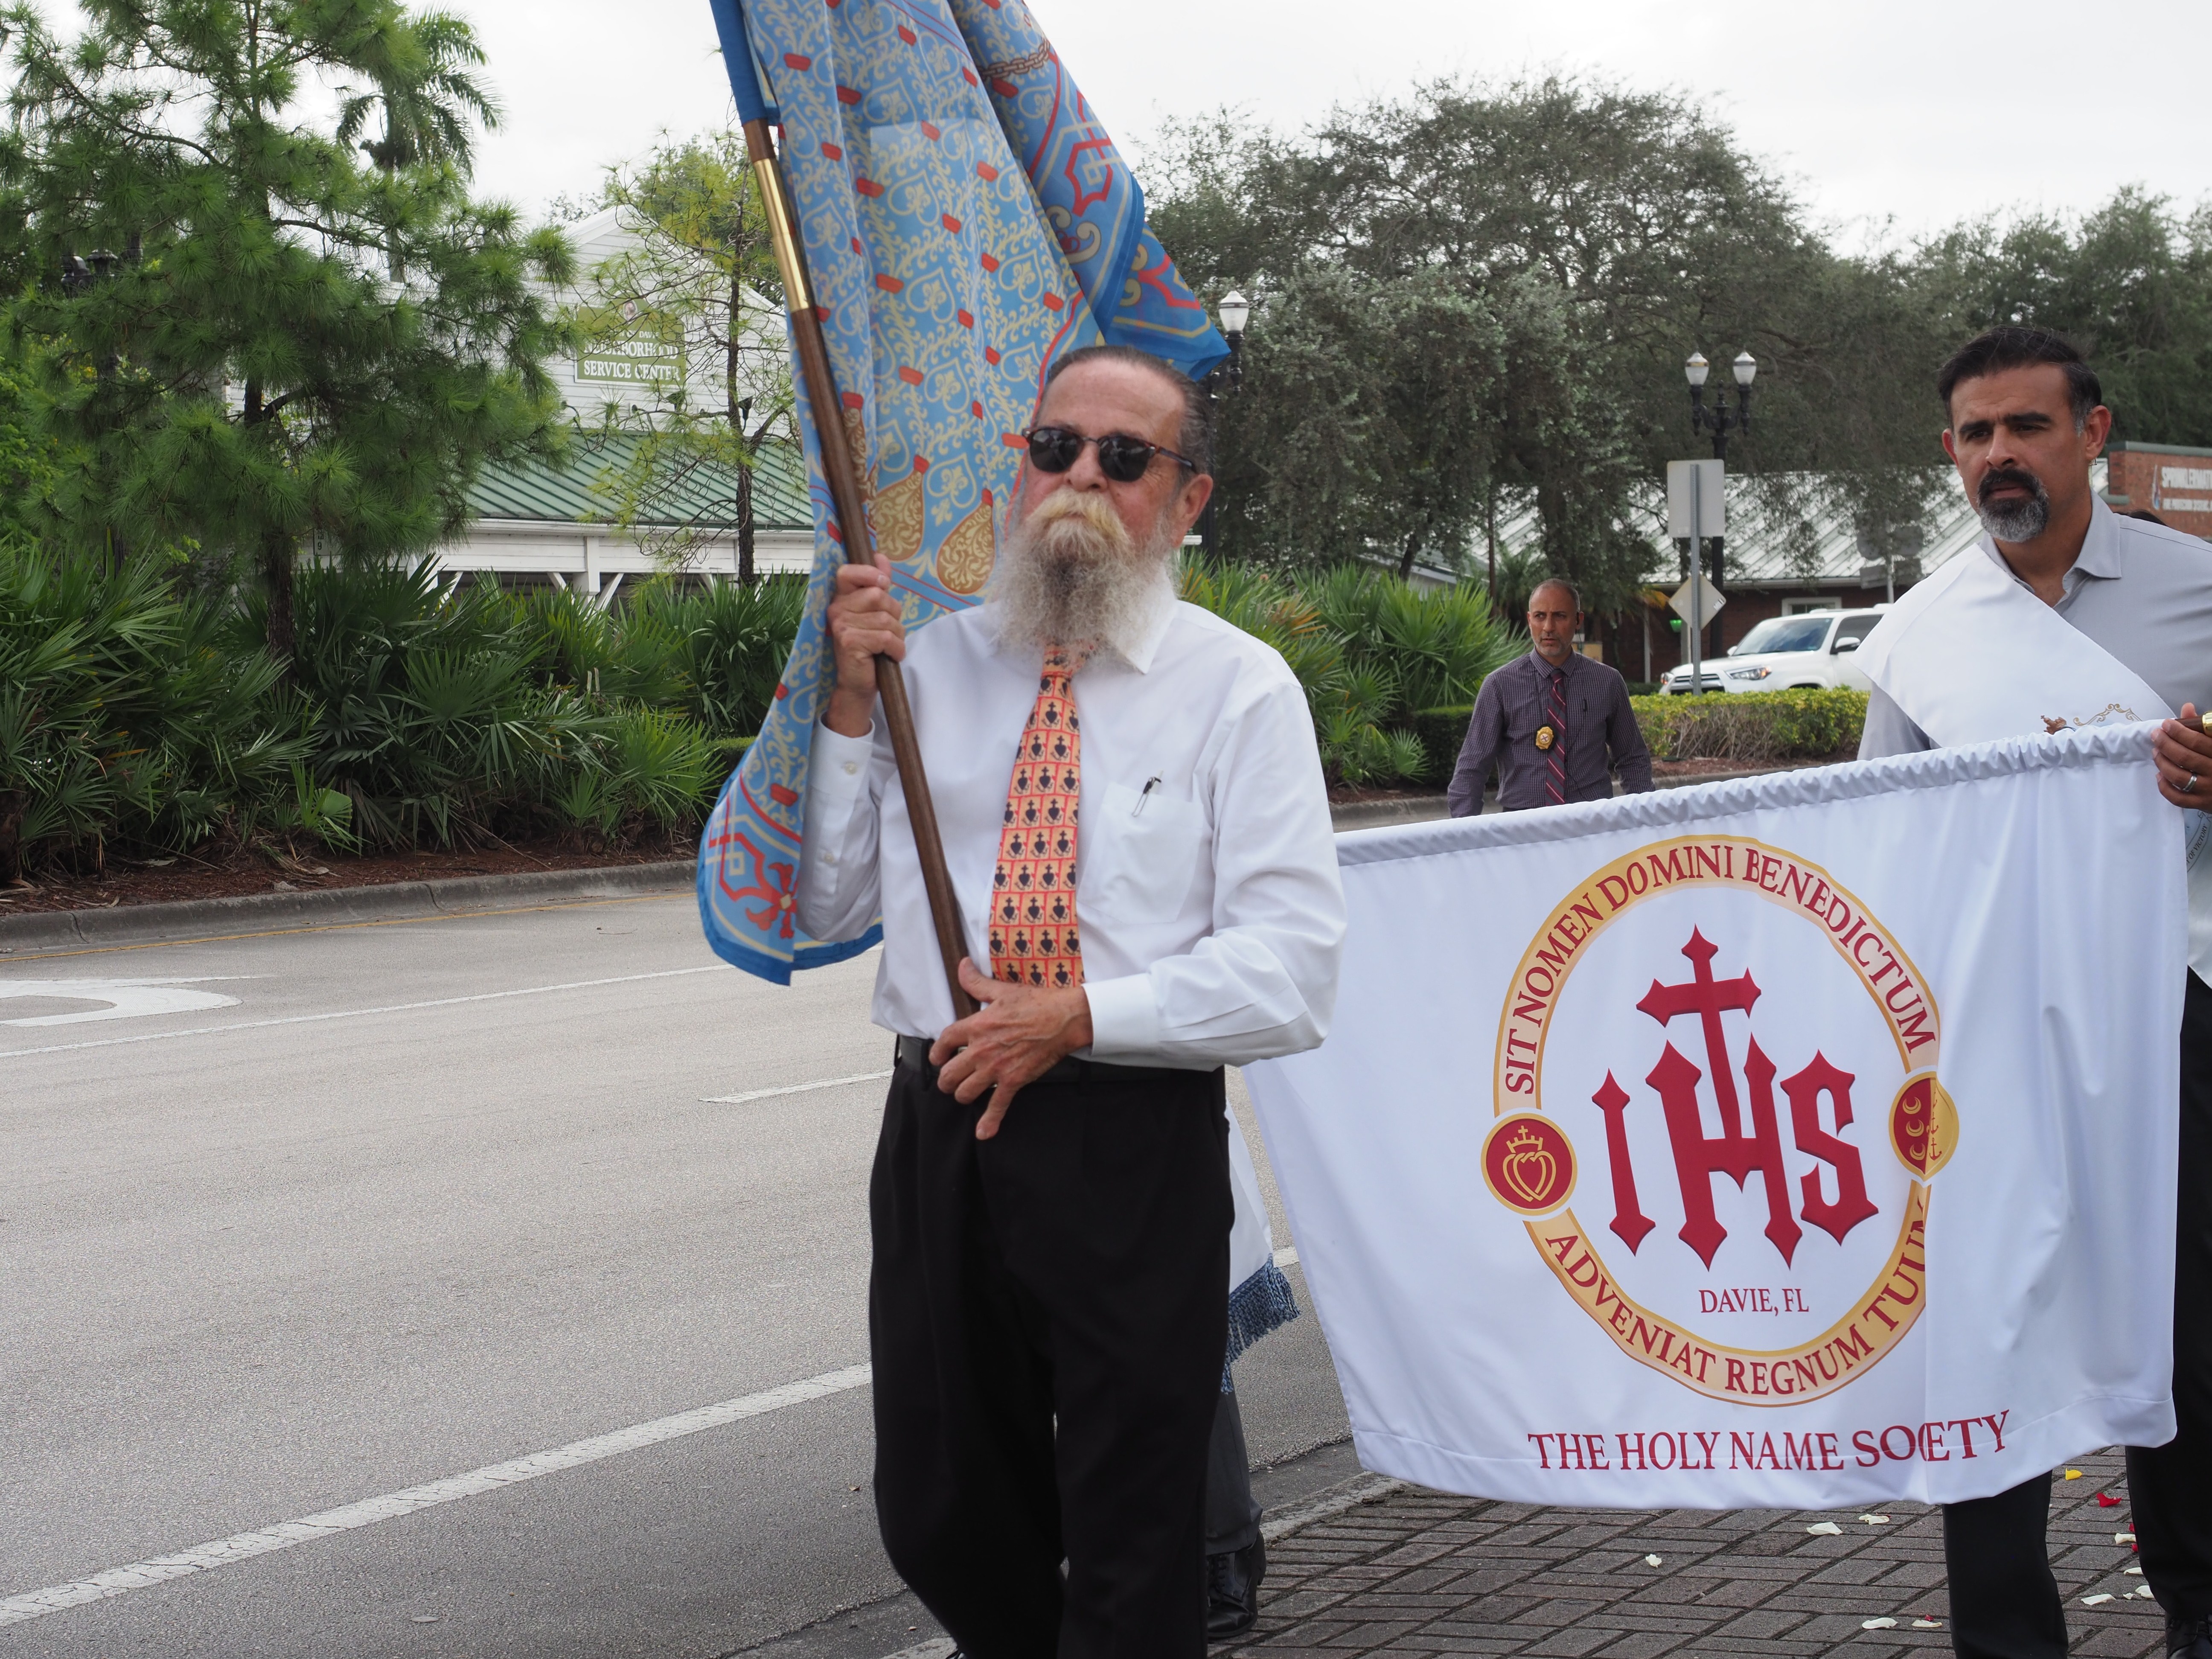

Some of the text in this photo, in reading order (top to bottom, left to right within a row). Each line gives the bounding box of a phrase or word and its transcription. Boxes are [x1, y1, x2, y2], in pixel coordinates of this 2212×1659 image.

[584, 360, 681, 381] SERVICE CENTER
[2189, 824, 2207, 860] OF VICTORY
[1505, 844, 1936, 1095] SIT NOMEN DOMINI BENEDICTUM
[1544, 1234, 1717, 1383] ADVENIAT
[1724, 1324, 1875, 1396] REGNUM
[1699, 1287, 1809, 1317] DAVIE, FL
[1527, 1432, 1610, 1470] THE
[1615, 1431, 1720, 1471] HOLY
[1729, 1432, 1844, 1471] NAME
